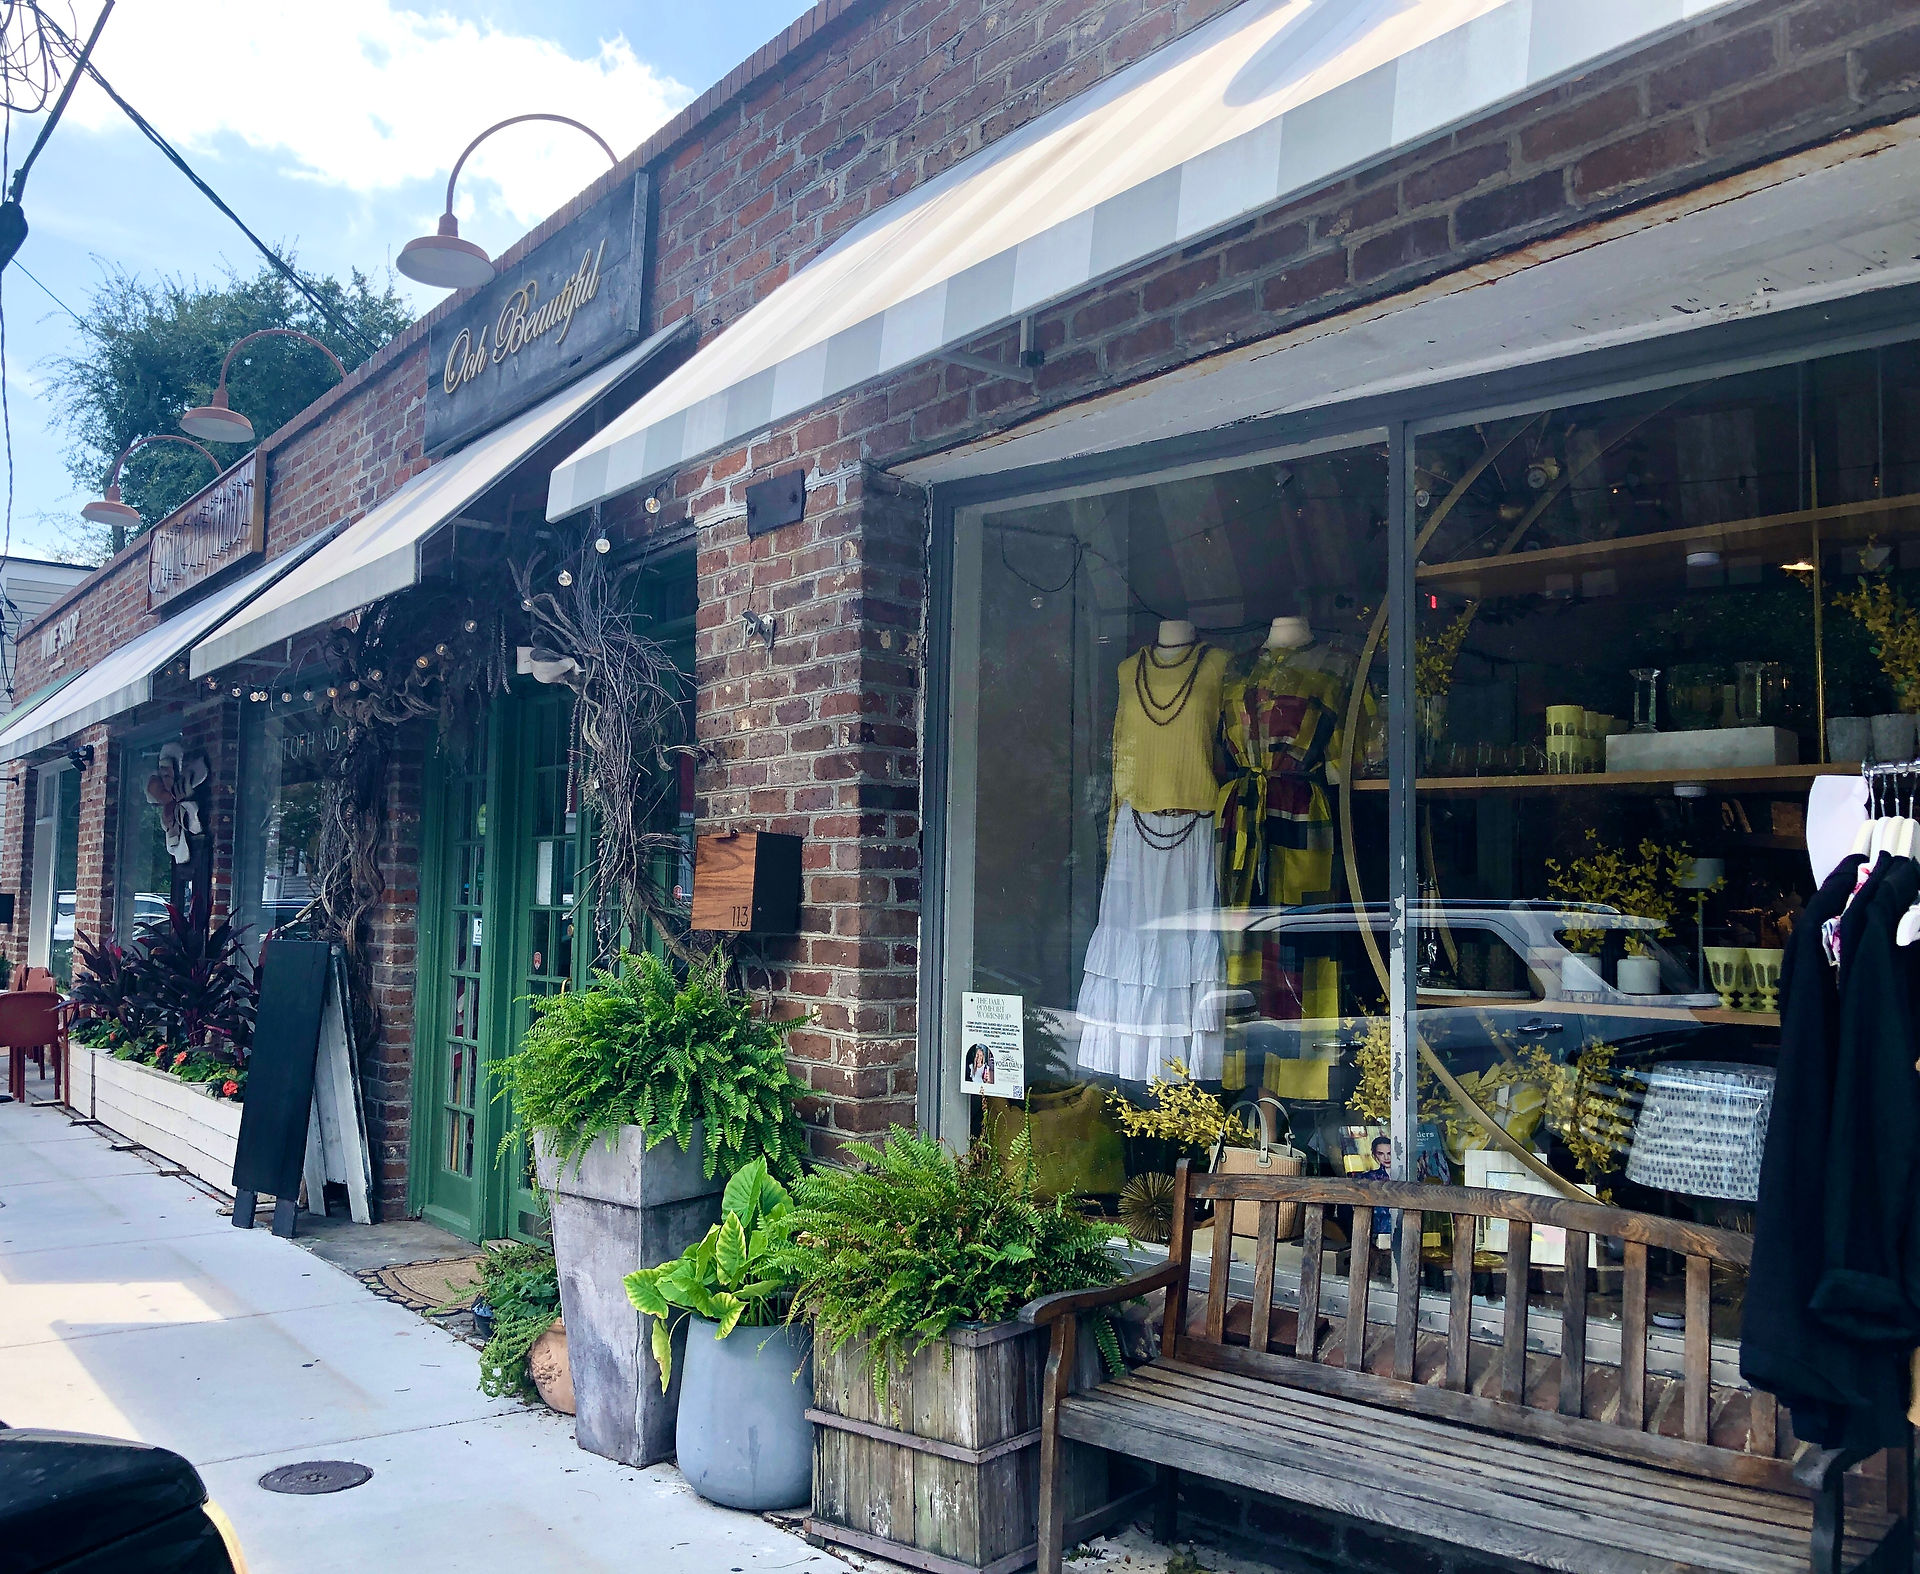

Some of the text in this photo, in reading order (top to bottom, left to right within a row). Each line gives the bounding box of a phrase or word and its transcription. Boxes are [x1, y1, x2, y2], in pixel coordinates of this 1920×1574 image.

[443, 237, 606, 394] Ooh Beautiful
[307, 725, 340, 756] HND
[732, 906, 748, 927] 113
